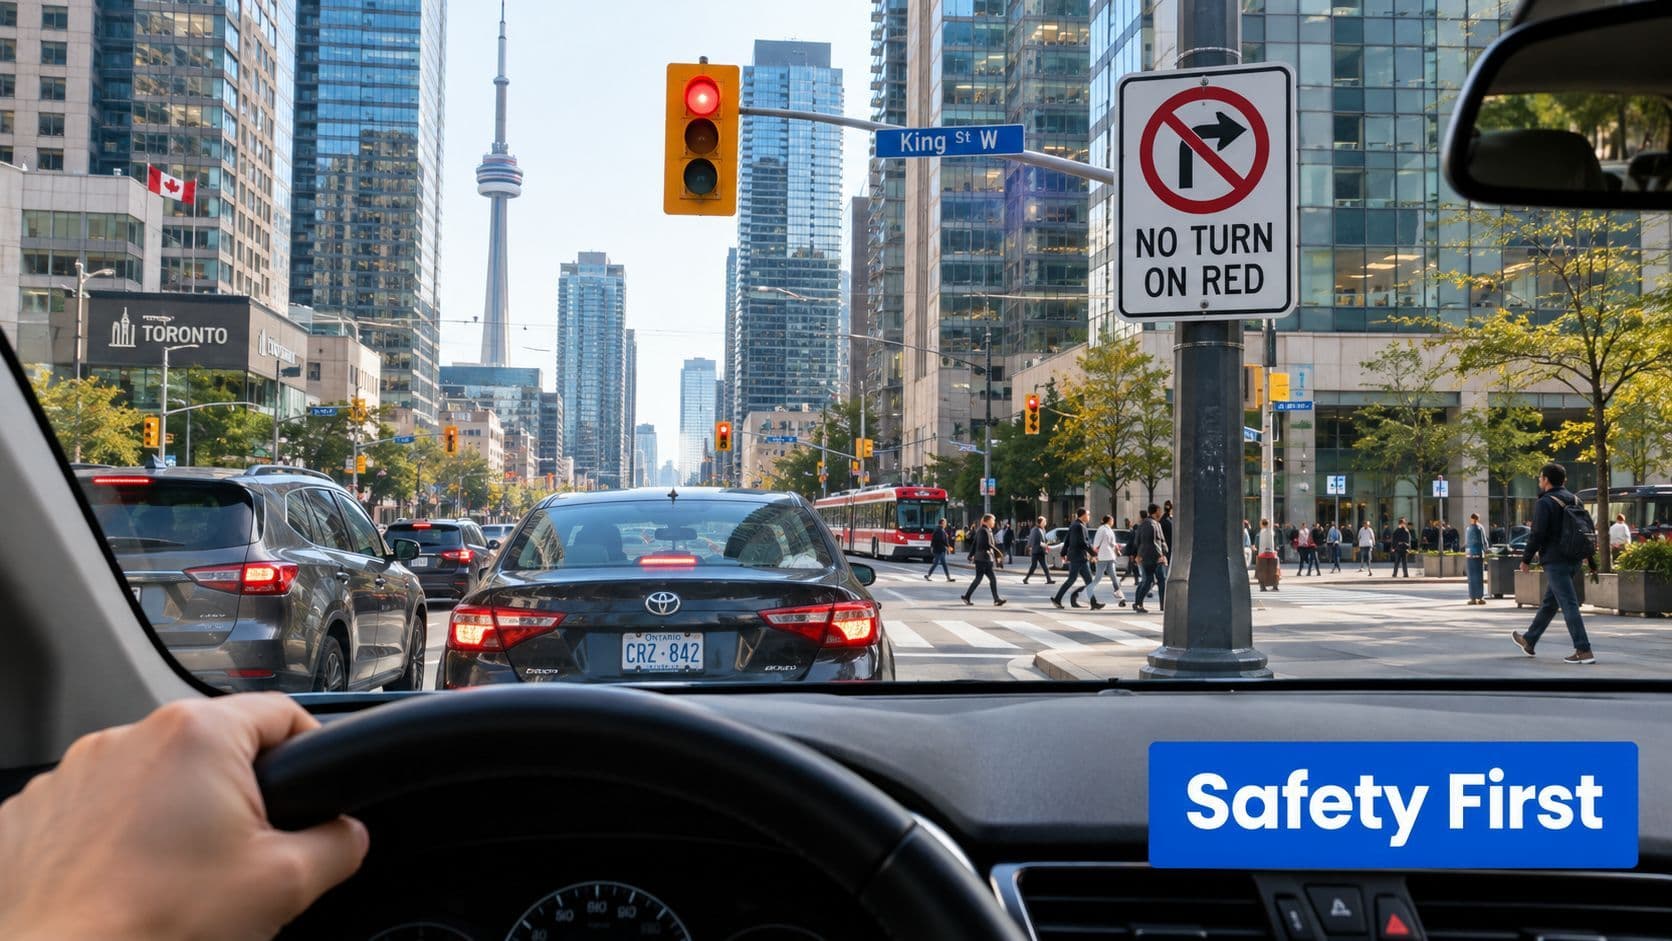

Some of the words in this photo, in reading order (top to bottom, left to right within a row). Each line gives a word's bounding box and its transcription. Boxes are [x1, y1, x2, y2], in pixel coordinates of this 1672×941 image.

[900, 132, 946, 154] King
[955, 130, 971, 145] St
[980, 129, 998, 150] W
[1136, 227, 1177, 258] NO
[1191, 222, 1273, 256] TURN
[1145, 266, 1187, 298] ON
[1203, 263, 1264, 295] RED
[142, 325, 228, 345] TORONTO
